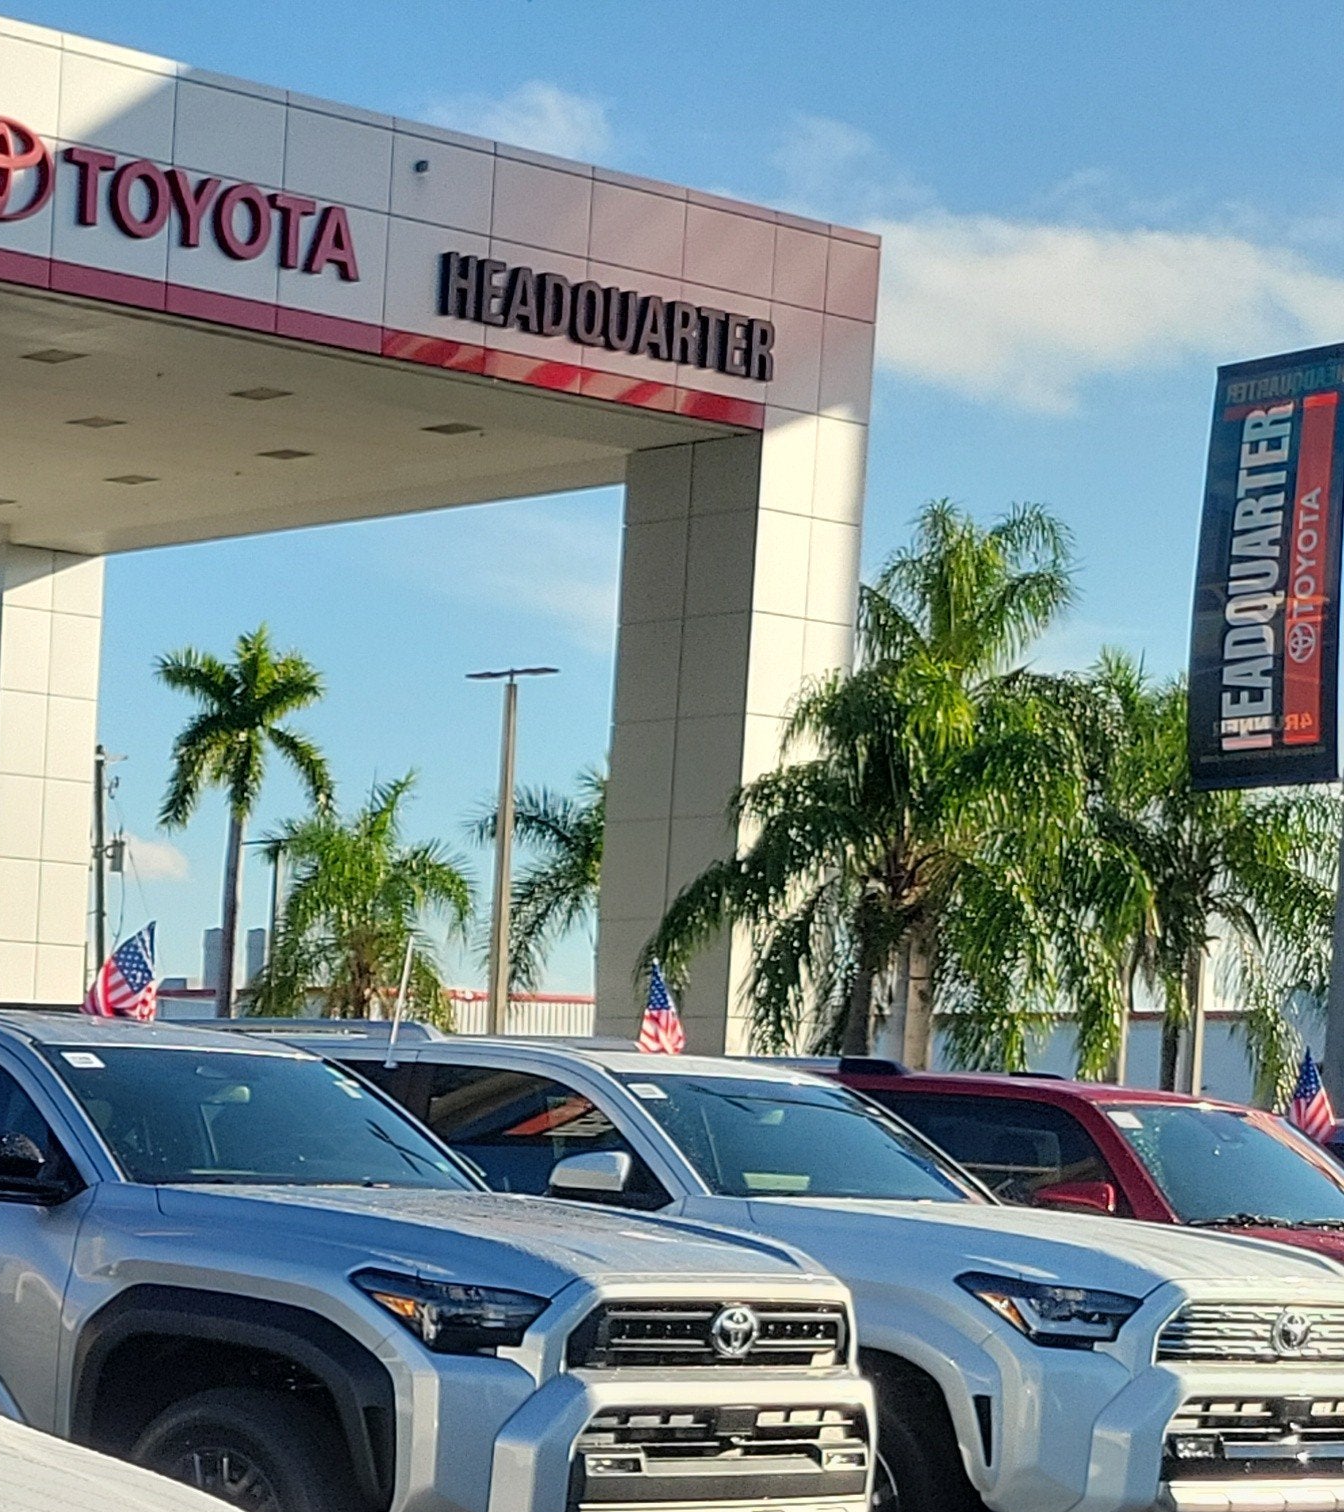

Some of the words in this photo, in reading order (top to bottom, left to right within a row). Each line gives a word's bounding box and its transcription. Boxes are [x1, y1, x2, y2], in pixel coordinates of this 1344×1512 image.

[64, 146, 360, 283] TOYOTA
[439, 250, 776, 382] HEADQUARTER
[1221, 400, 1295, 752] HEADQUARTER
[1292, 487, 1322, 619] TOYOTA
